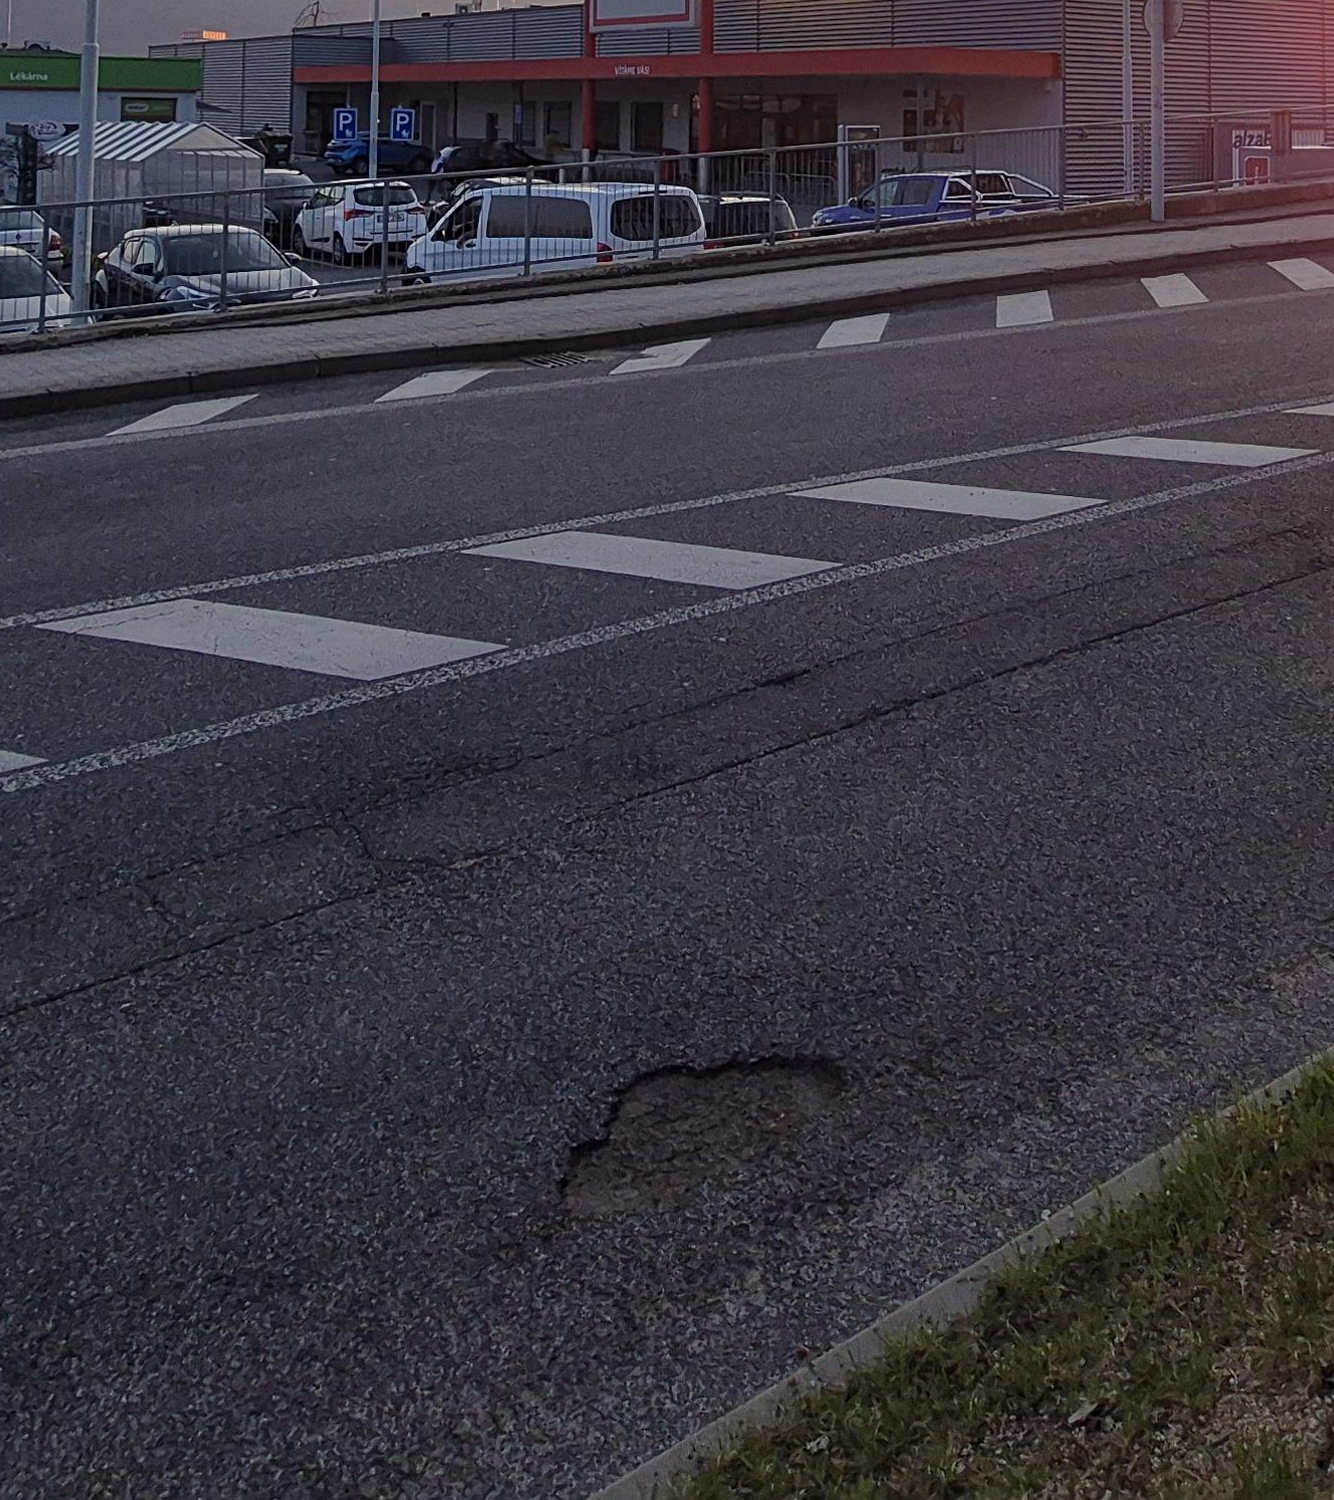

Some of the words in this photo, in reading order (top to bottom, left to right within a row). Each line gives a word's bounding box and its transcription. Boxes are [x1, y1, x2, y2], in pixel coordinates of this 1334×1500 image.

[10, 71, 48, 81] Lékárna
[339, 113, 353, 131] P
[396, 113, 410, 132] P
